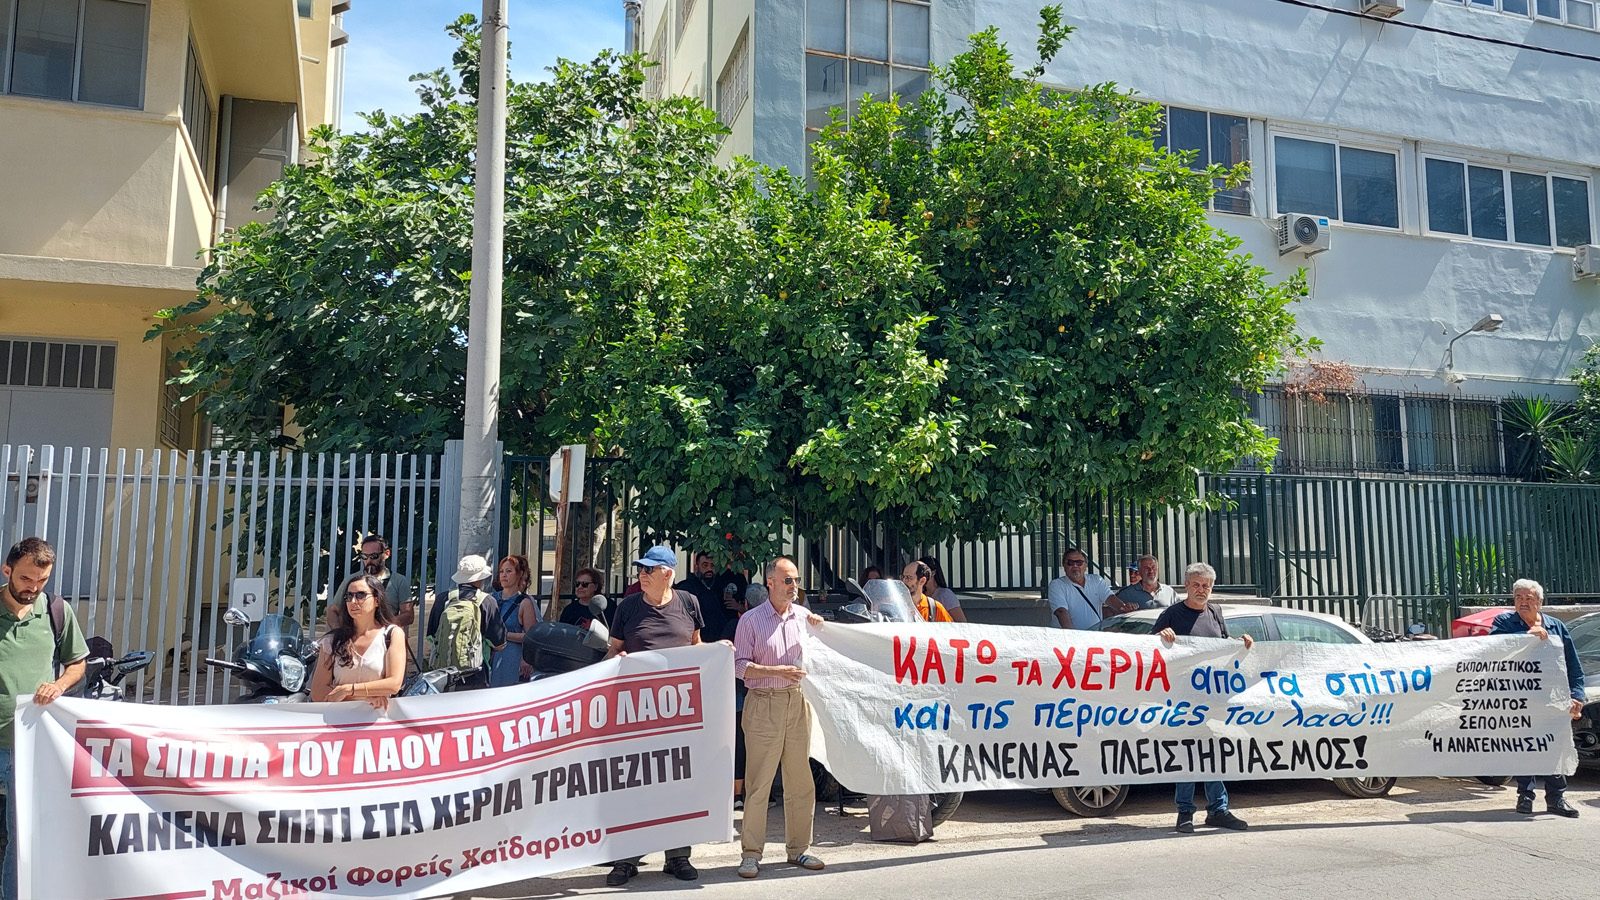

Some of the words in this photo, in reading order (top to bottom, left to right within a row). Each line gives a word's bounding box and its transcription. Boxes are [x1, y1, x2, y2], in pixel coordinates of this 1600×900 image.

[893, 636, 998, 685] ΚΑΤΩ
[1012, 660, 1042, 686] ΤΑ
[1052, 647, 1171, 692] ΧΕΡΙΑ
[1191, 660, 1246, 694] από
[1260, 671, 1303, 698] τα
[1326, 663, 1432, 697] σπίτια
[1456, 661, 1542, 673] ΕΚΠΟΛΙΤΙΣΤΙΚΟΣ
[894, 702, 950, 730] και
[1225, 706, 1275, 726] του
[1282, 699, 1394, 728] λαού!!!
[1459, 715, 1531, 730] ΣΕΠΟΛΙΩΝ
[1462, 698, 1528, 711] ΣΥΛΛΟΓΟΣ
[86, 738, 133, 778] ΤΑ
[143, 738, 269, 778] ΣΠΙΤΙΑ
[278, 739, 345, 778] ΤΟΥ
[353, 732, 444, 774] ΛΑΟΥ
[451, 725, 495, 763] ΤΑ
[499, 699, 581, 753] ΣΩΖΕΙ
[589, 695, 607, 729] Ο
[615, 682, 695, 726] ΛΑΟΣ
[938, 740, 1079, 783] ΚΑΝΕΝΑΣ
[1100, 735, 1368, 776] ΠΛΕΙΣΤΗΡΙΑΣΜΟΣ!
[88, 811, 247, 857] ΚΑΝΕΝΑ
[256, 807, 351, 844] ΣΠΙΤΙ
[362, 800, 424, 840] ΣΤΑ
[431, 778, 524, 831] ΧΕΡΙΑ
[532, 746, 692, 805] ΤΡΑΠΕΖΙΤΗ
[212, 866, 338, 900] Μαζικοί
[347, 854, 453, 888] Φορείς
[460, 827, 602, 872] Χαϊδαρίου
